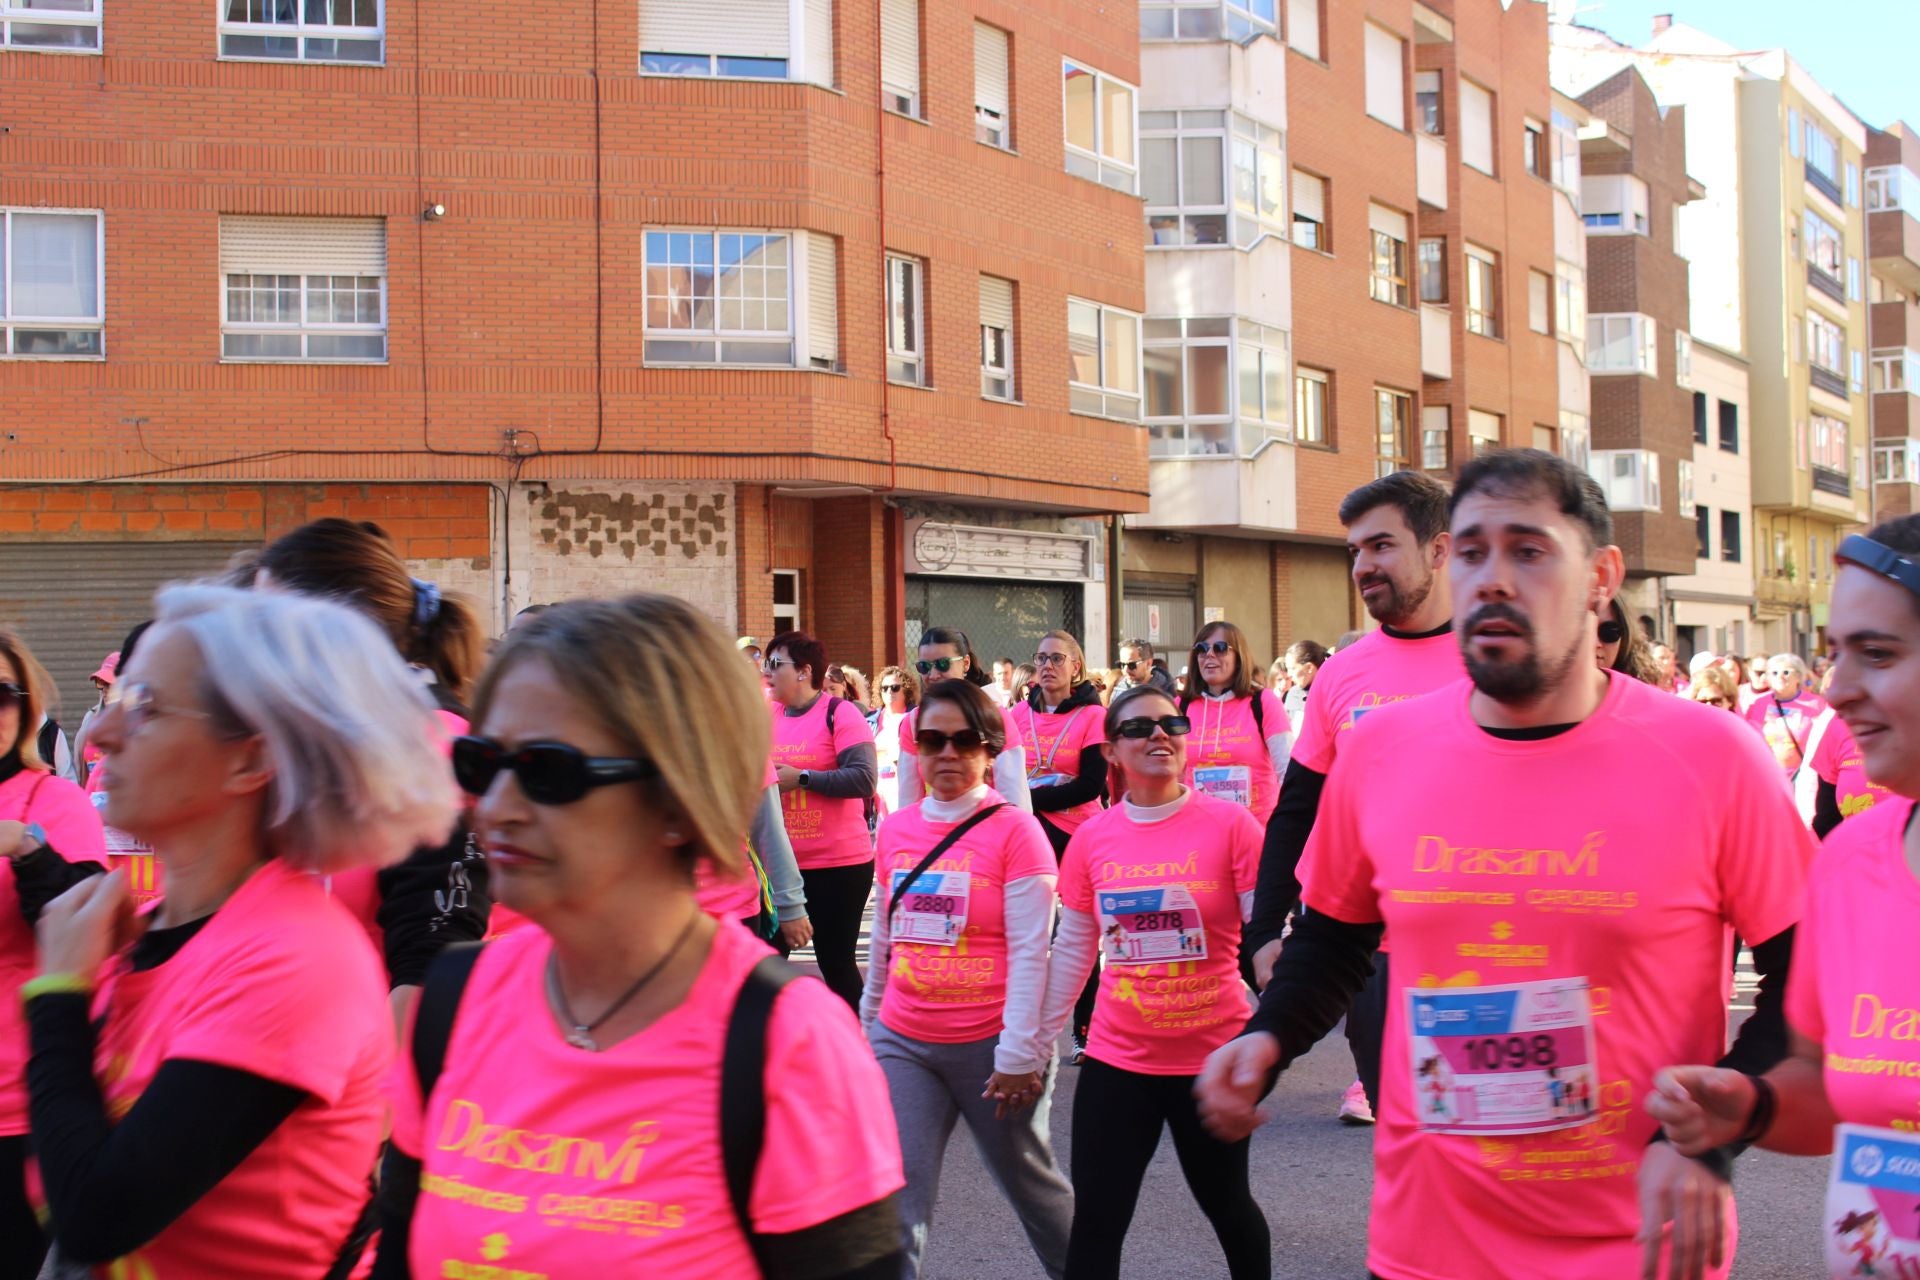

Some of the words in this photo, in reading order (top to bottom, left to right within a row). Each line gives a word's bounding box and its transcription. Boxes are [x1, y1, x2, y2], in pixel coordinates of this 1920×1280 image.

[1212, 781, 1239, 791] 4552
[912, 895, 956, 914] 2880
[1134, 911, 1184, 931] 2878
[1141, 975, 1219, 994] Carrera
[1462, 1033, 1558, 1070] 1098
